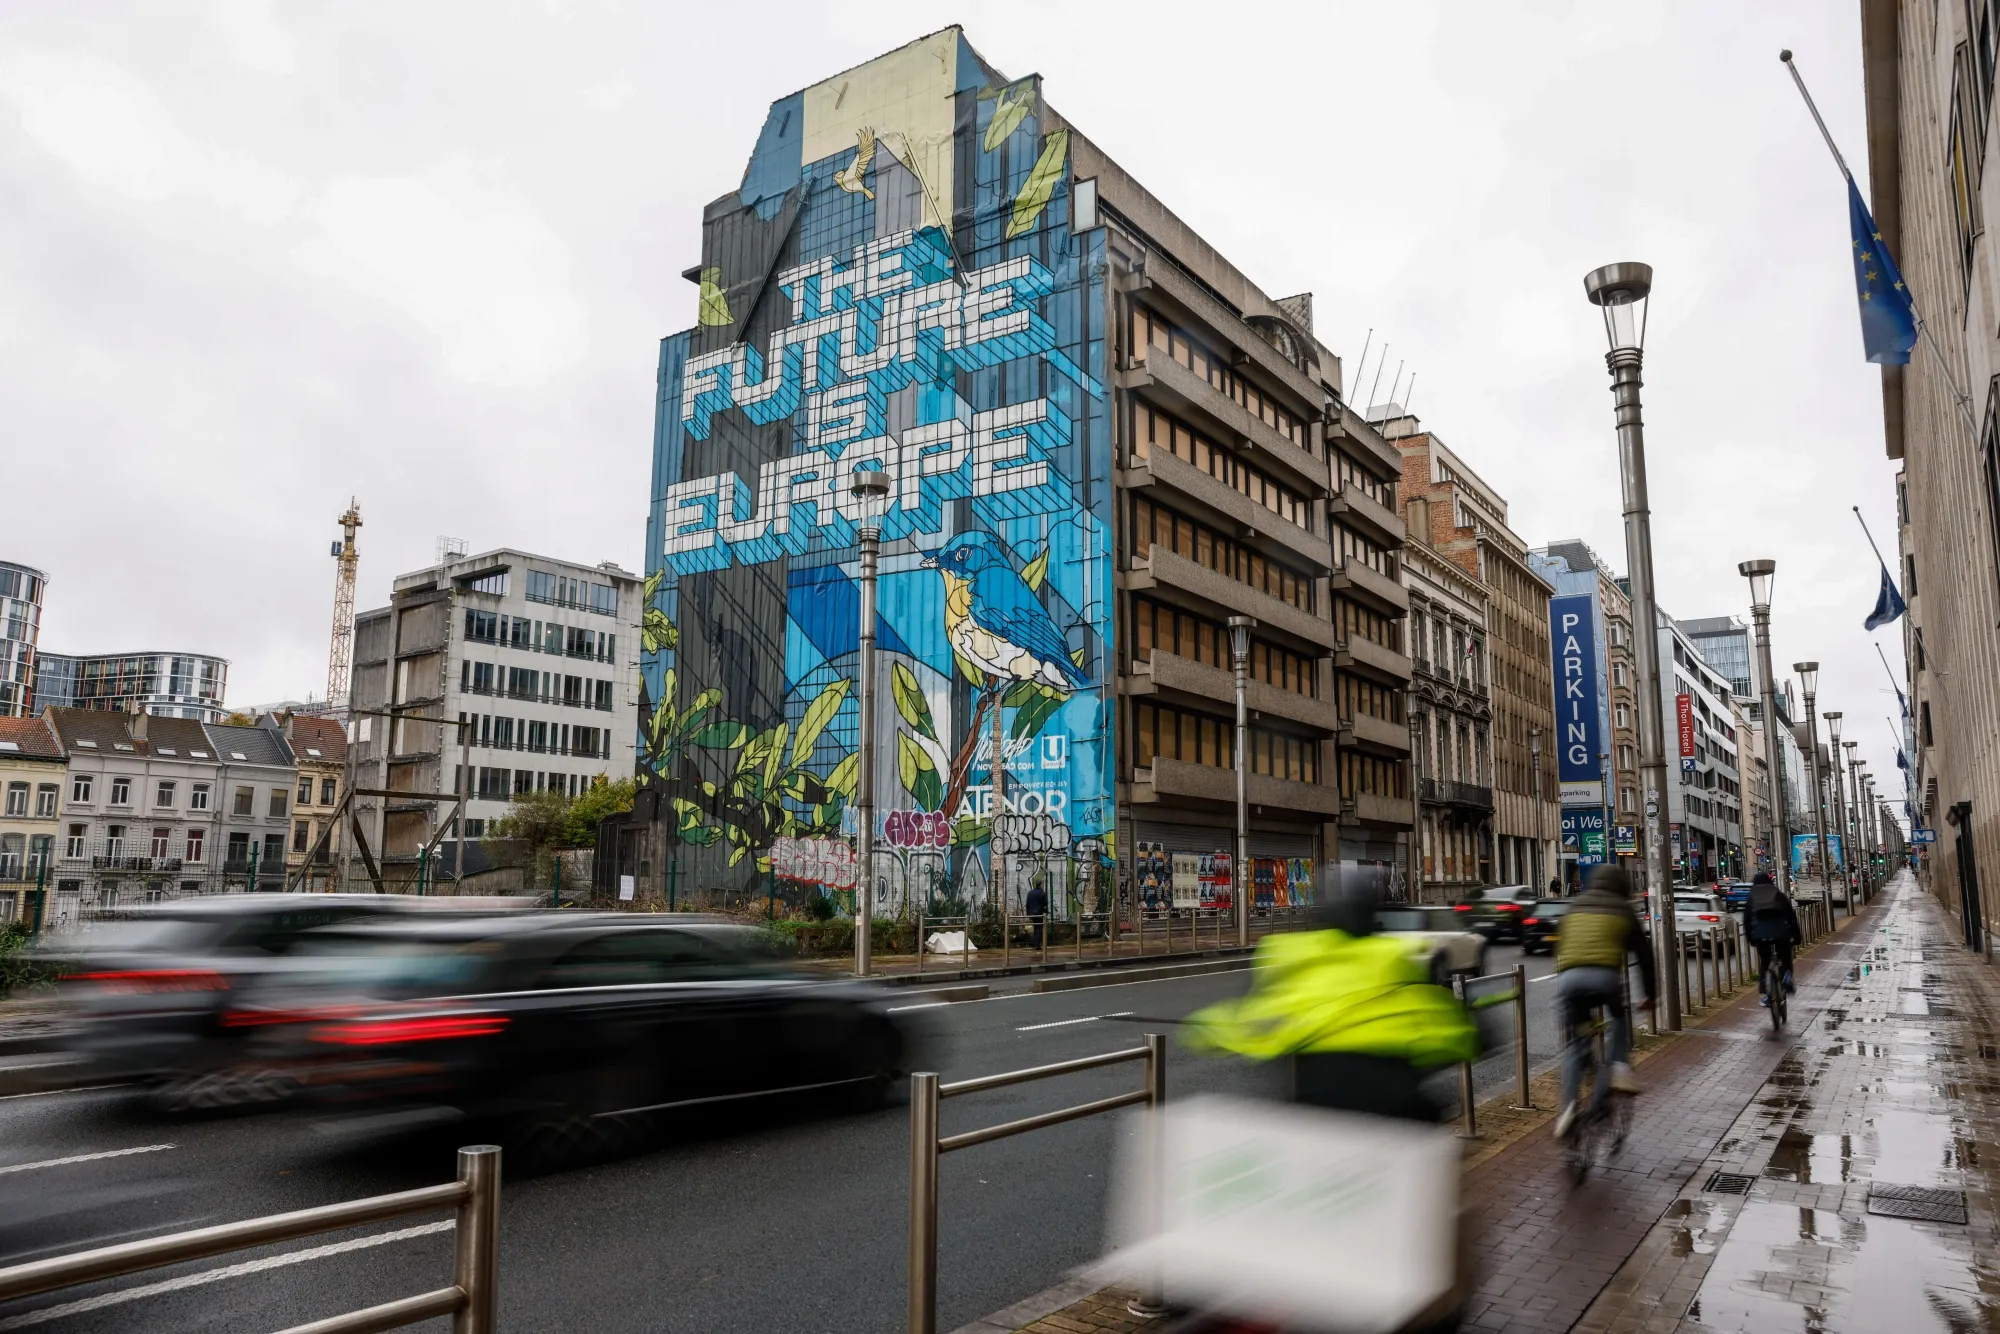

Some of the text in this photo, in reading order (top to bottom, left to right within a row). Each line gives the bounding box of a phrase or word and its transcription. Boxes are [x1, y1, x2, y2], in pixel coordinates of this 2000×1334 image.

[777, 229, 925, 323] THE
[682, 254, 1036, 428] FUTURE
[807, 378, 872, 448] IS
[664, 398, 1056, 560] EUROPE
[1562, 613, 1588, 765] PARKING
[1681, 703, 1689, 723] Thon
[1682, 727, 1691, 752] Hotels
[1683, 760, 1690, 769] P
[1008, 782, 1055, 790] EMPOWERED
[955, 785, 1067, 825] ATENOR
[1562, 816, 1603, 829] oi We
[1618, 826, 1627, 838] P
